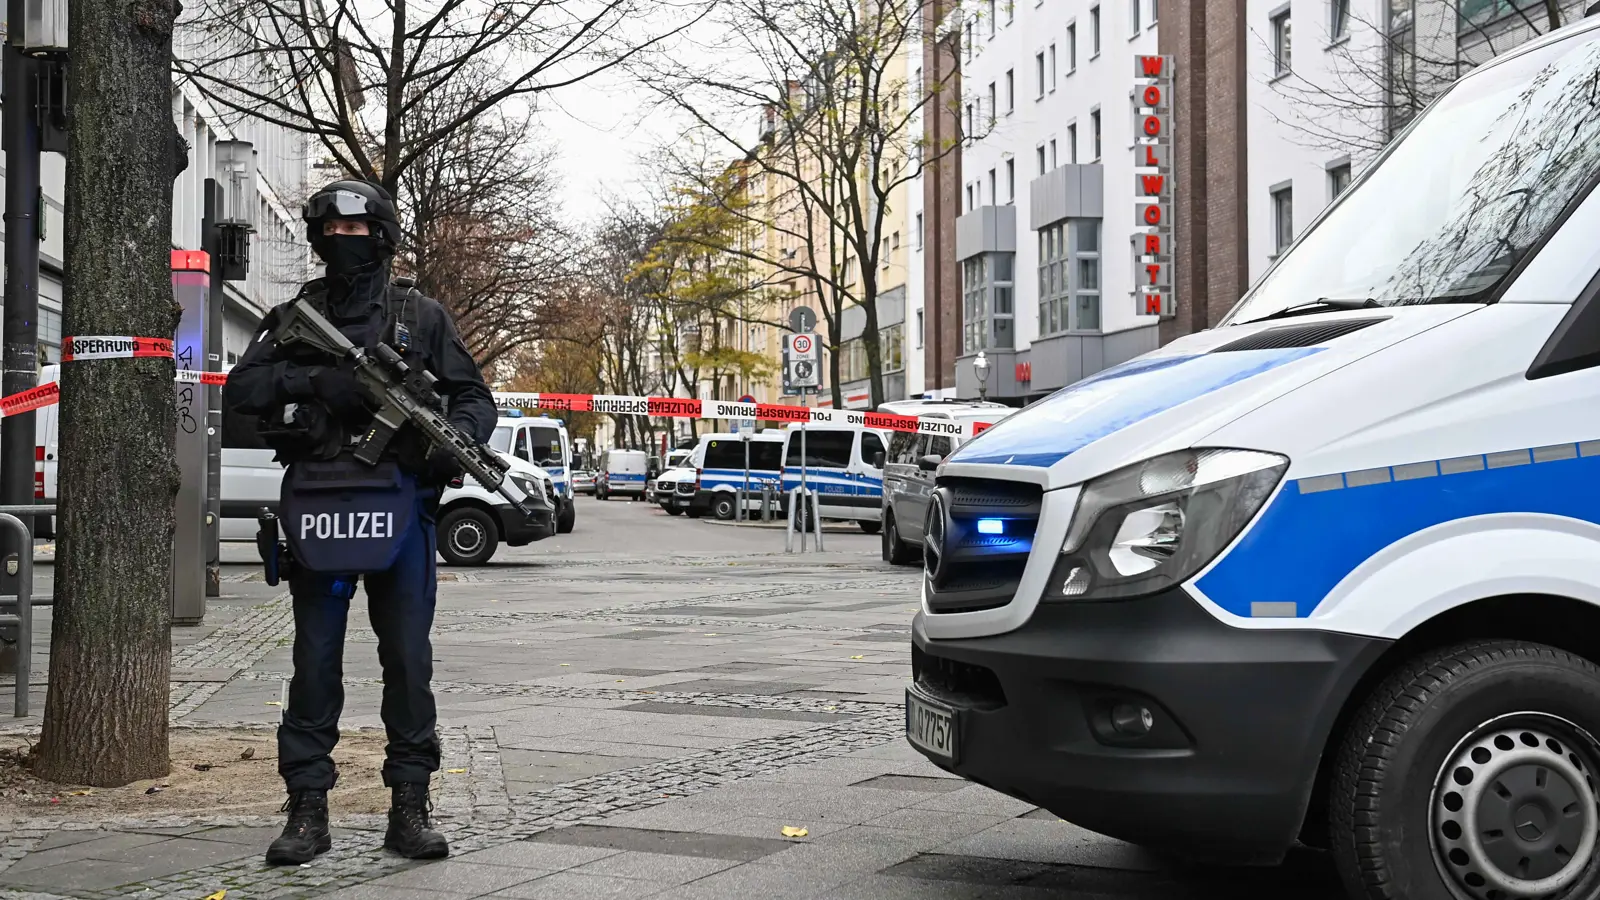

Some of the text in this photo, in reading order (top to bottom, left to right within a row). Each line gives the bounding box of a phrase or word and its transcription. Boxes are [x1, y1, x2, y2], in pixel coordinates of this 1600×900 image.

[1141, 56, 1163, 314] WOOLWORTH
[796, 340, 808, 349] 30
[586, 399, 702, 415] POLIZEIABSPERRUNG
[717, 404, 832, 422] POLIZEIABSPERRUNG
[847, 414, 962, 434] POLIZEIABSPERRUNG
[824, 485, 845, 493] POLIZEI
[300, 512, 393, 540] POLIZEI
